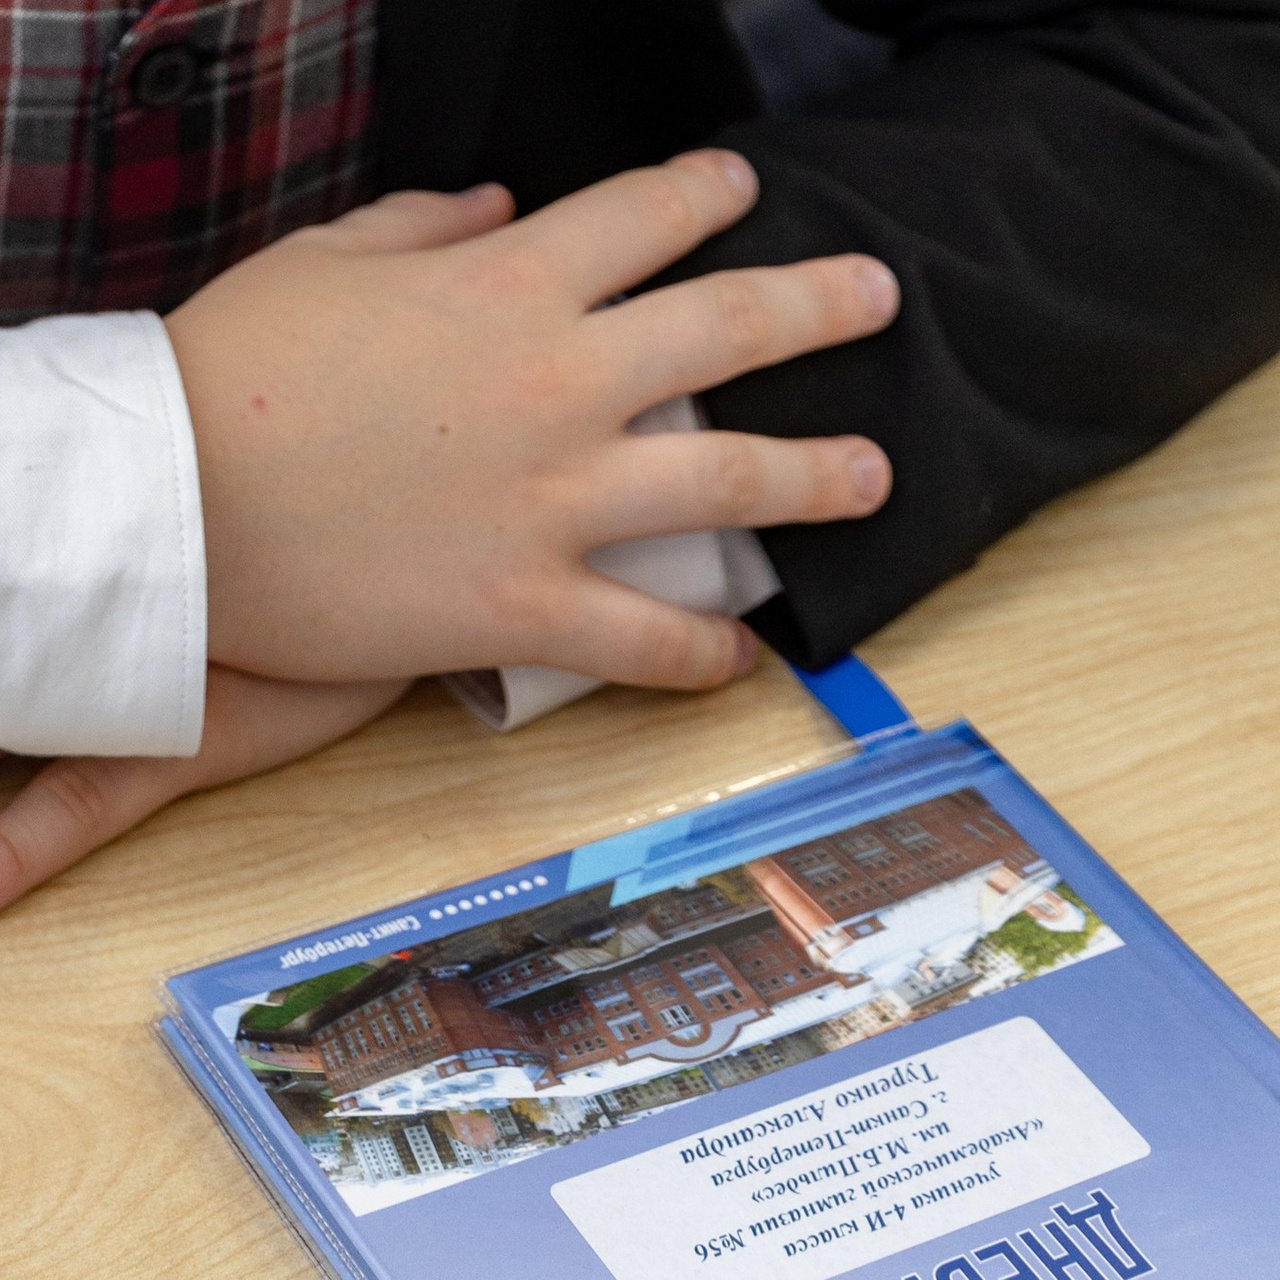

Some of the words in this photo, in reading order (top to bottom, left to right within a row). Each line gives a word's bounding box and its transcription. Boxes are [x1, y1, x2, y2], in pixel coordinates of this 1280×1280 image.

[280, 915, 422, 969] Санкт-Петербург
[835, 1062, 939, 1108] Туренко
[931, 1091, 947, 1104] г.
[679, 1100, 825, 1165] Александра
[710, 1100, 929, 1187] Санкт-Петербурга
[911, 1121, 951, 1142] им.
[751, 1137, 910, 1203] М.Б.Пильдес»
[860, 1118, 1044, 1198] «Академической
[910, 1160, 1001, 1209] ученика
[748, 1188, 856, 1237] гимназии
[864, 1203, 905, 1233] 4-И
[693, 1228, 746, 1262] №56
[783, 1219, 859, 1257] класса
